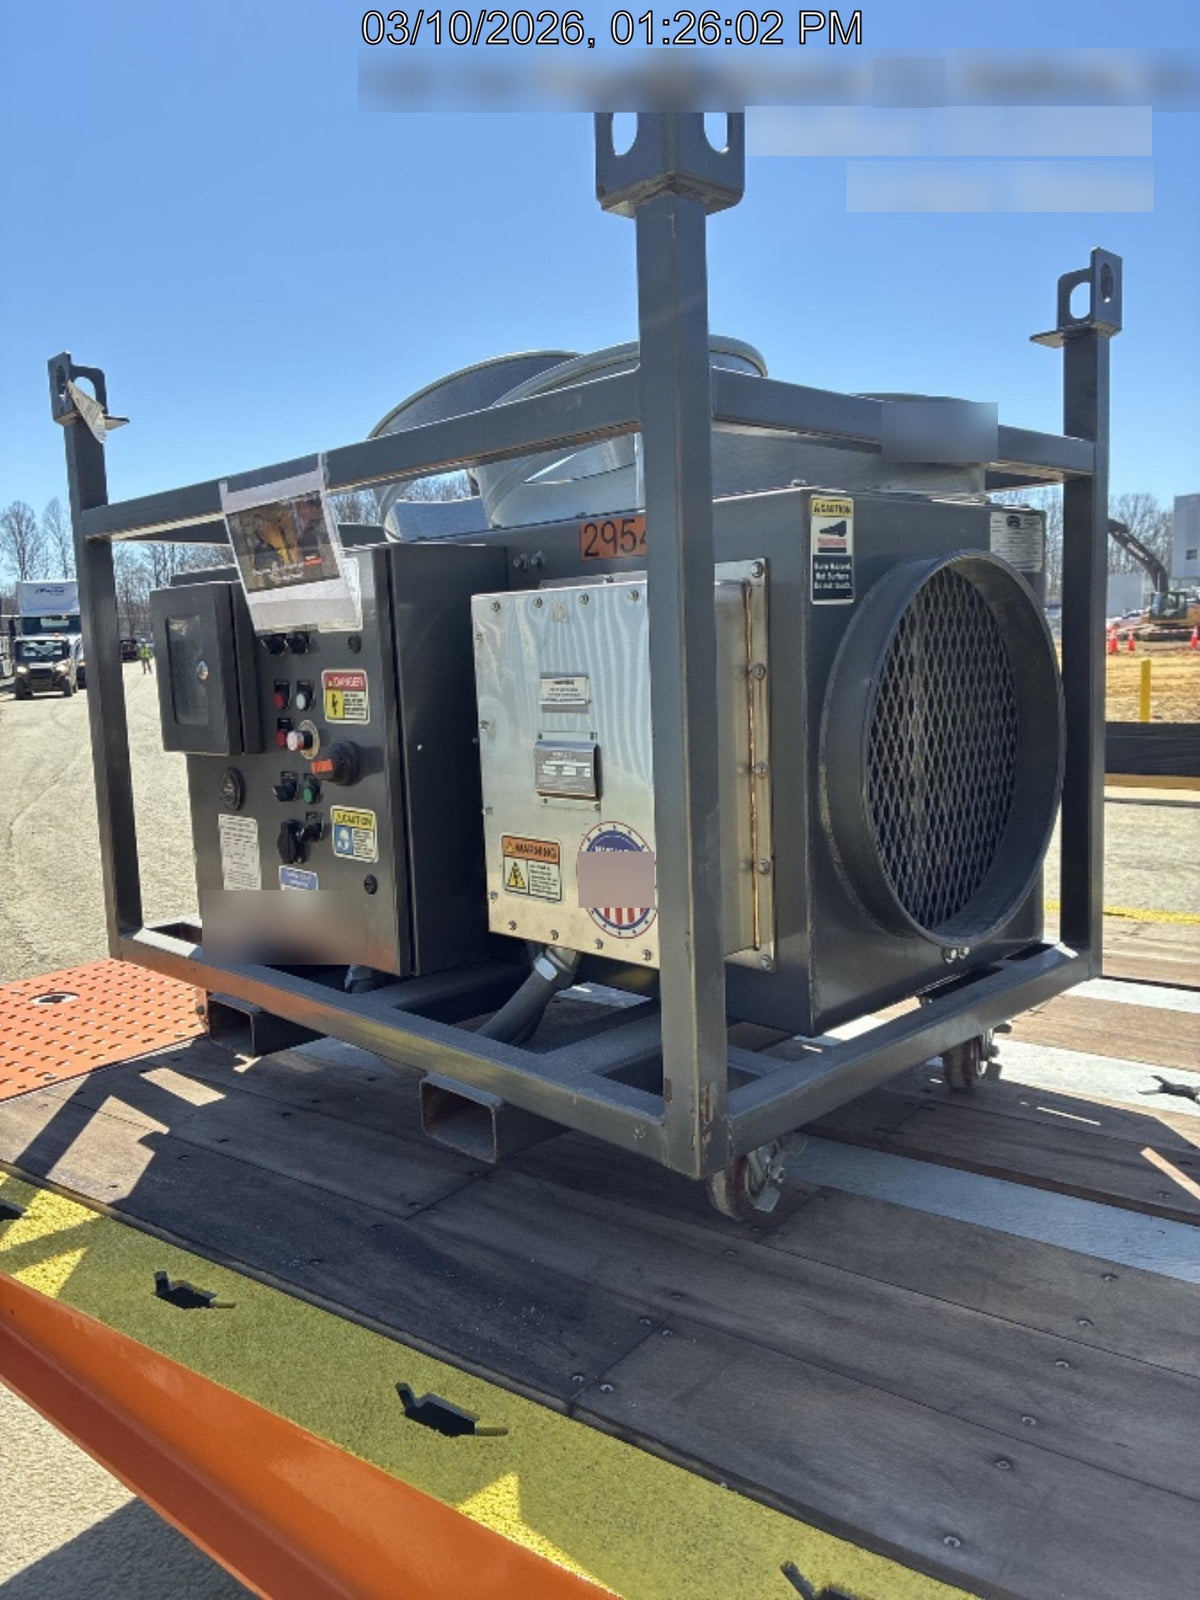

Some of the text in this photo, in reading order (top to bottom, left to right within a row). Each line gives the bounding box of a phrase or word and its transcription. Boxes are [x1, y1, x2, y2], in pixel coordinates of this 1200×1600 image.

[821, 503, 851, 514] CAUTION
[333, 676, 364, 687] DANGER
[515, 843, 557, 860] WARNING
